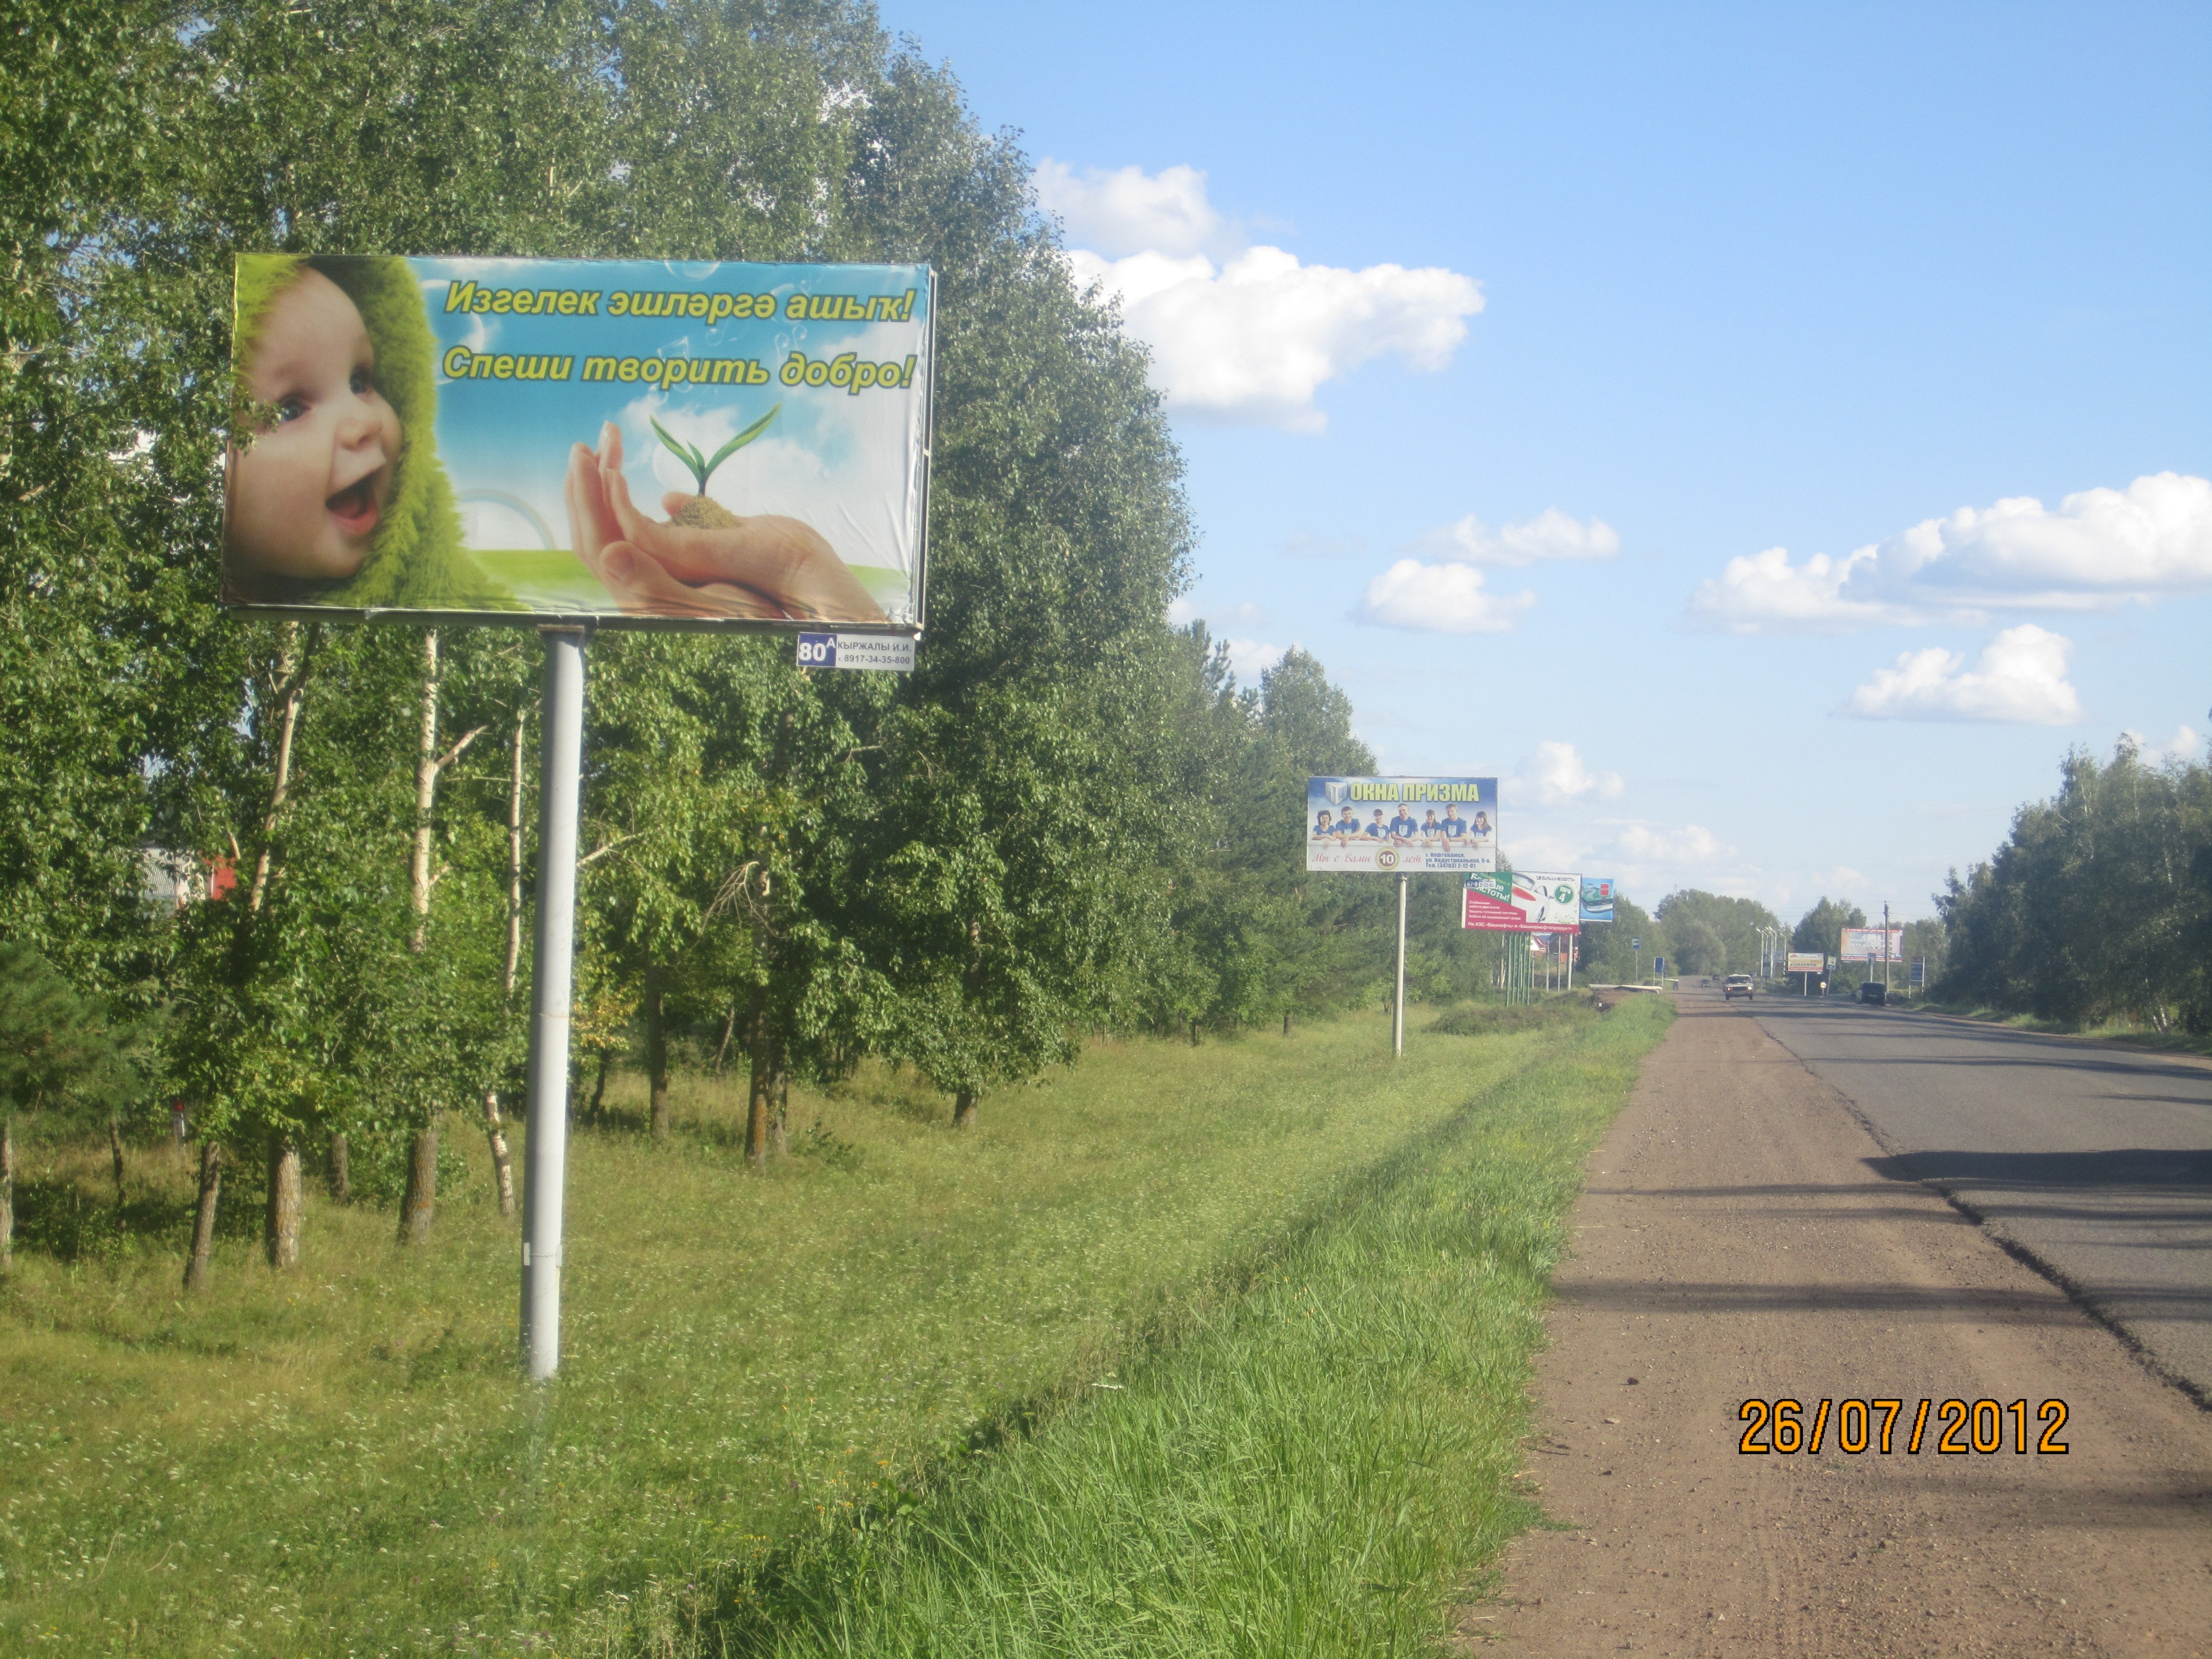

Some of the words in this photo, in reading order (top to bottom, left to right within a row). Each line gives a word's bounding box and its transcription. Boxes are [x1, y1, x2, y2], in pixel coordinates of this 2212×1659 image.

[443, 281, 602, 316] Изгелек
[607, 289, 776, 327] эшләргә
[784, 288, 917, 322] ашыҡ!
[442, 345, 575, 381] Спеши
[581, 354, 771, 392] творить
[779, 351, 918, 396] добро!
[838, 640, 889, 651] КЫРЖАЛЫ
[893, 644, 911, 652] И.И.
[844, 654, 910, 664] 8917-34-35-800
[1350, 782, 1399, 802] ОКНА
[1402, 783, 1480, 802] ПРИЗМА
[1312, 853, 1329, 863] Мы
[1345, 853, 1371, 863] Вами
[1380, 854, 1395, 864] 10
[1559, 893, 1566, 902] 4
